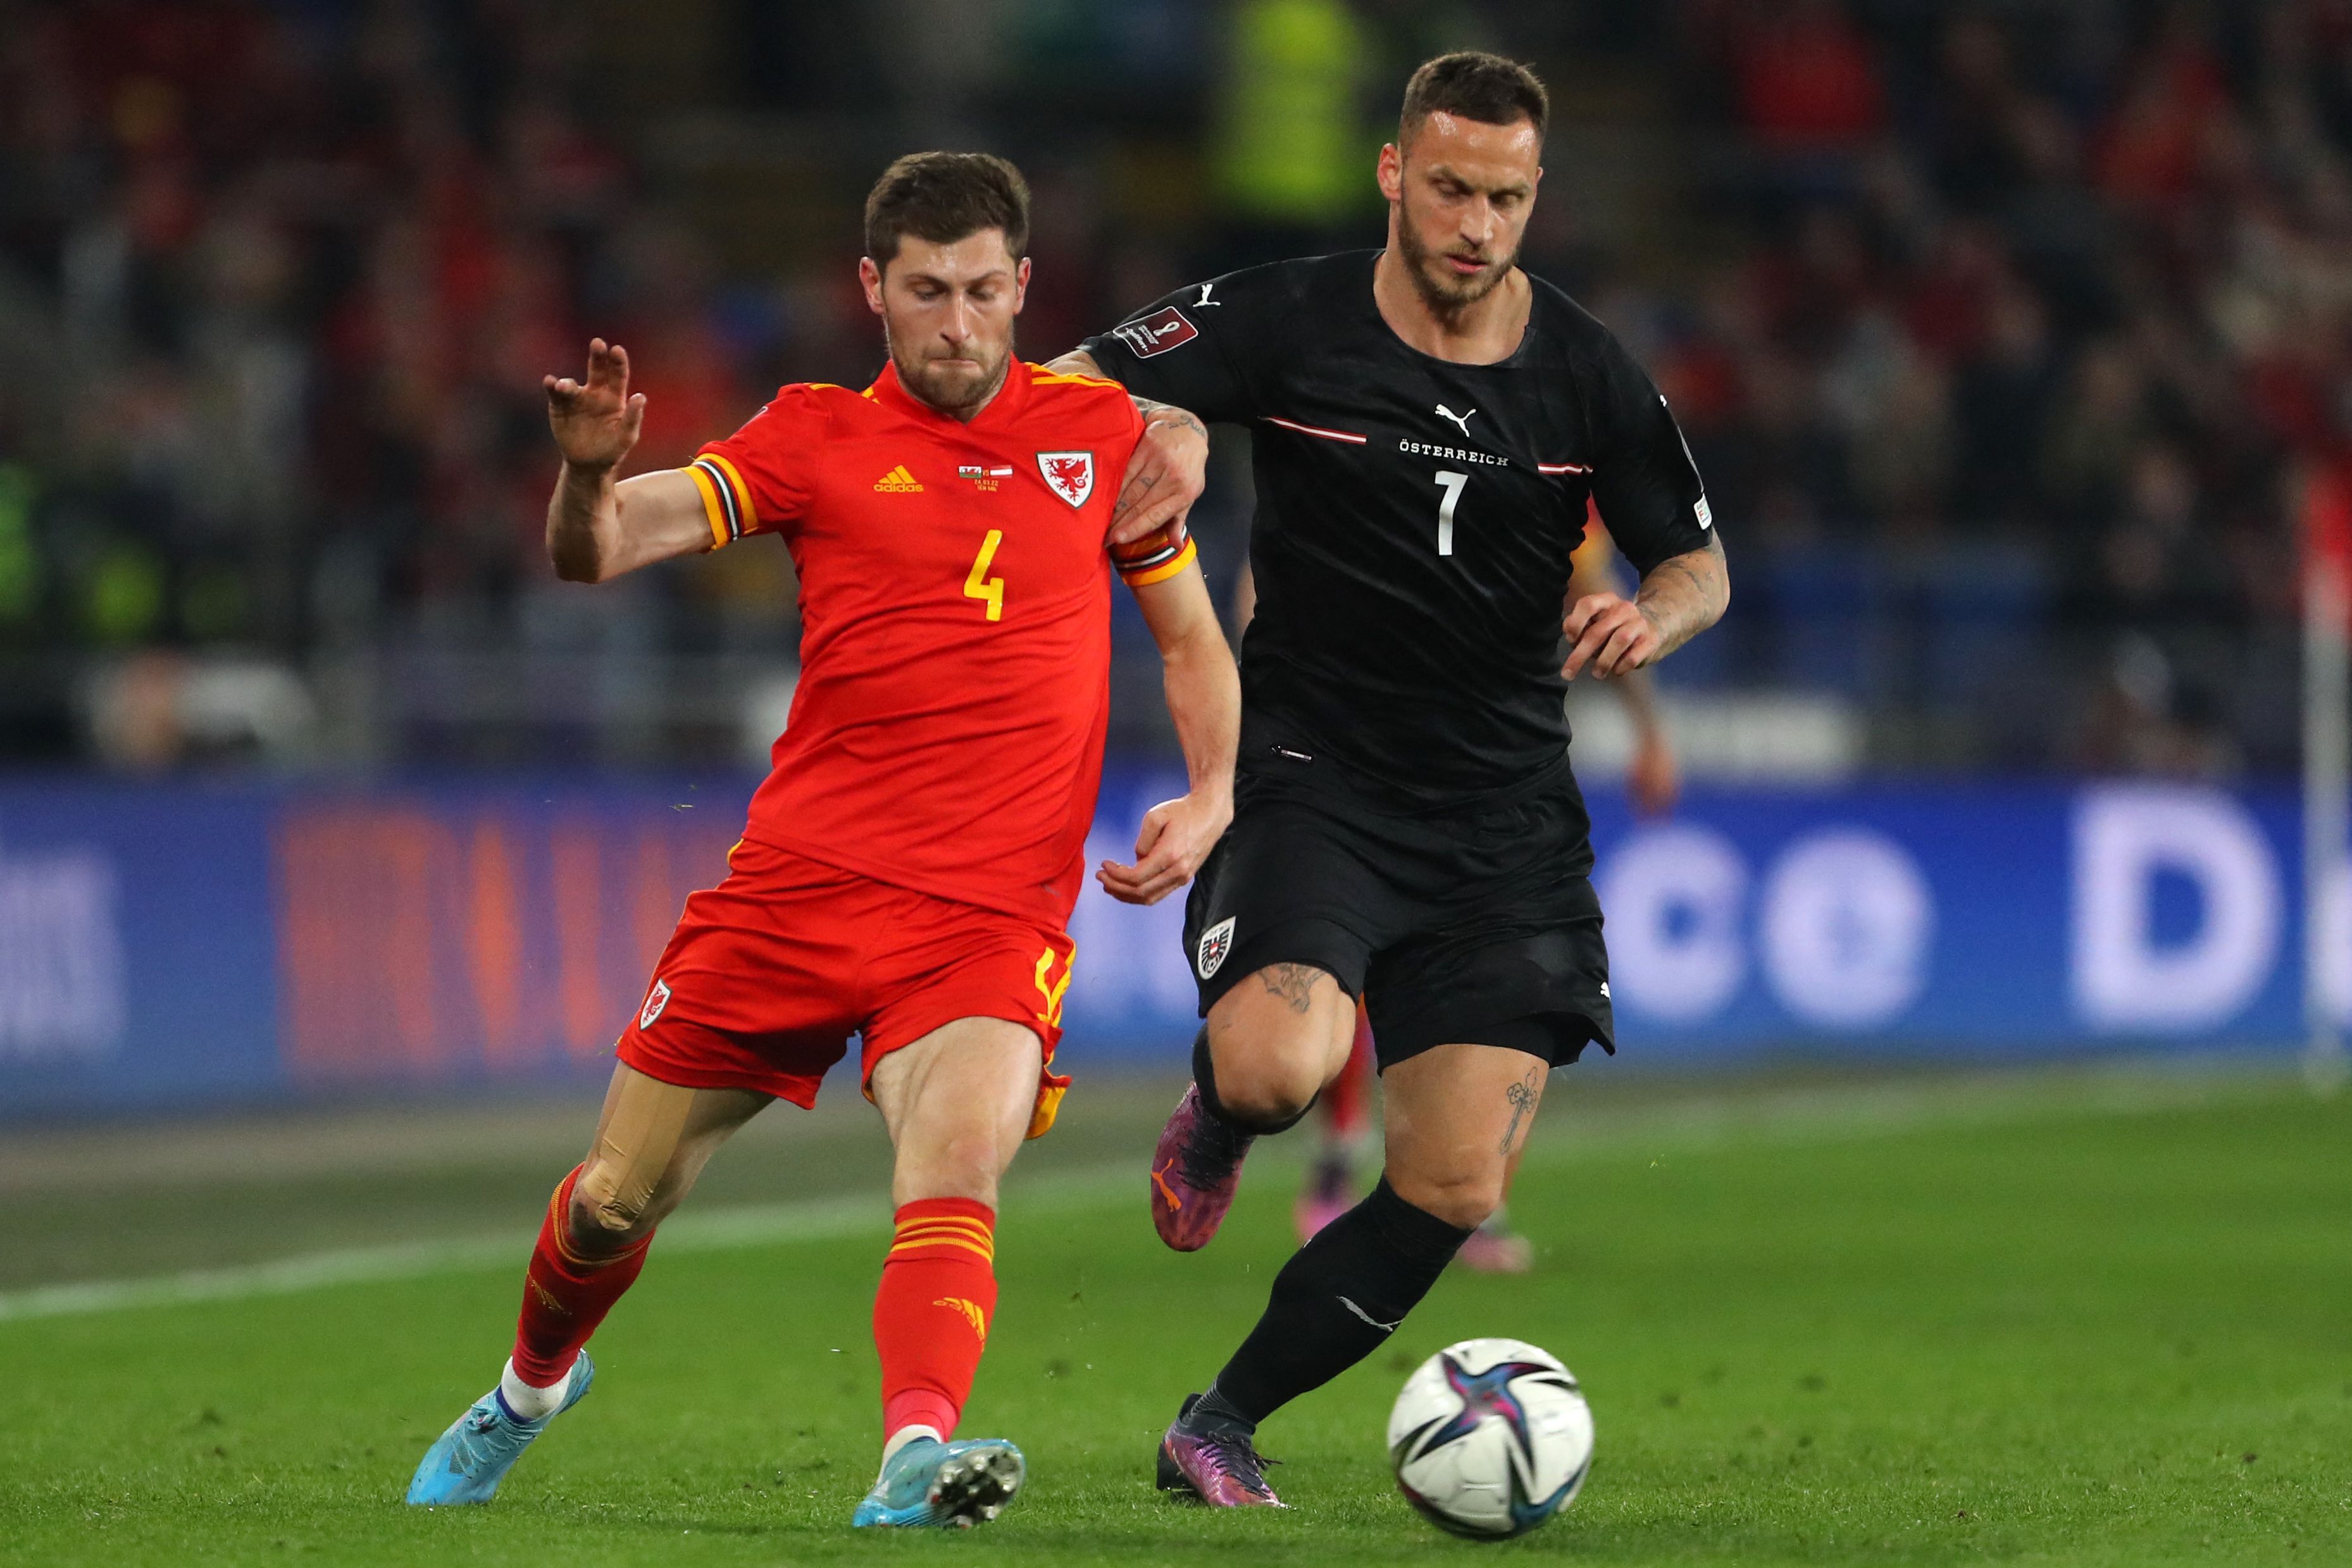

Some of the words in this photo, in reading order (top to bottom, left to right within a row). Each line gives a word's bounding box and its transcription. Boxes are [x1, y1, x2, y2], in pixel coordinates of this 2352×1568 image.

[1399, 439, 1509, 466] ÖSTERREICH
[873, 483, 924, 493] adidas
[1434, 470, 1469, 556] 7
[963, 529, 1005, 622] 4
